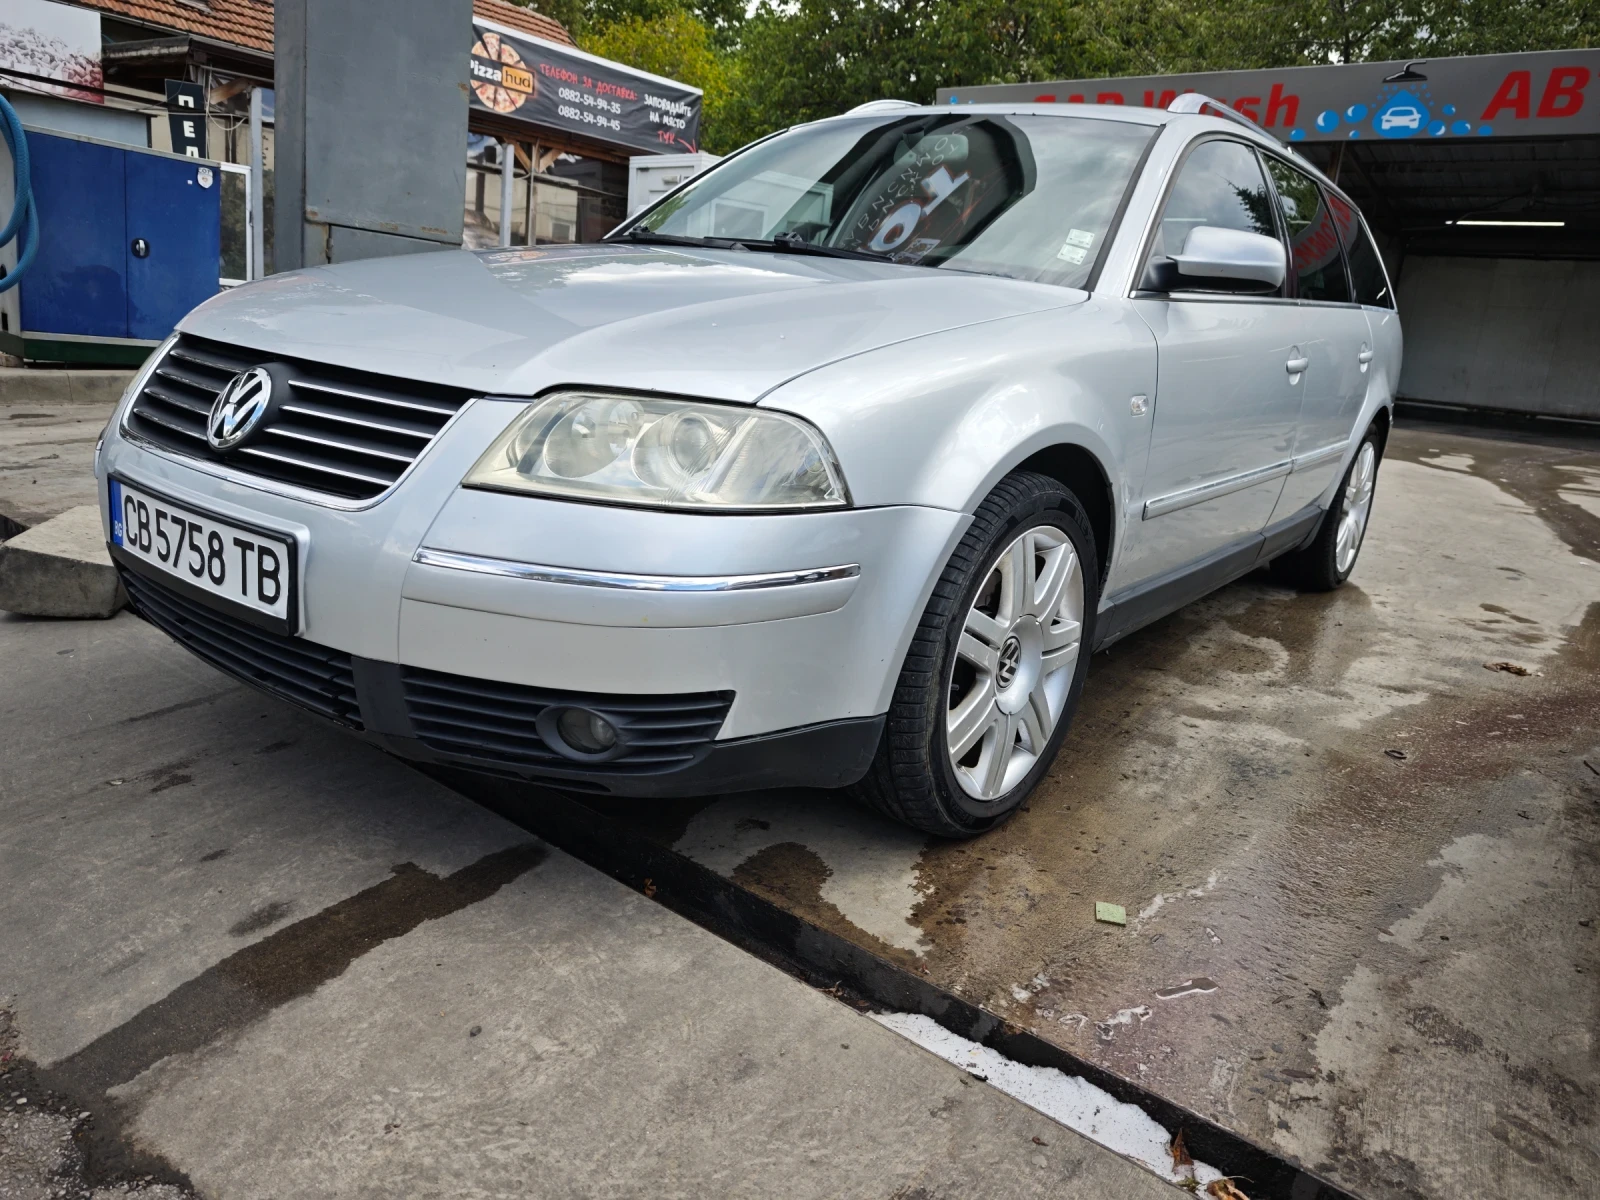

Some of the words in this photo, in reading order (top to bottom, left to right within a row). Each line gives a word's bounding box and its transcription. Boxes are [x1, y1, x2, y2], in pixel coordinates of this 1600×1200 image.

[505, 69, 531, 88] hud
[539, 63, 578, 84] ТЕЛЕФОН
[583, 76, 592, 88] ЗА
[596, 82, 638, 101] ДОСТАВКА:
[558, 87, 621, 115] 0882-54-94-35
[1480, 66, 1600, 120] АВ
[649, 111, 660, 123] НА
[662, 115, 686, 130] МЯСТО
[658, 130, 675, 145] ТУК
[114, 520, 123, 537] BG
[124, 494, 151, 554] CB
[155, 508, 226, 586] 5758
[233, 537, 281, 605] TB
